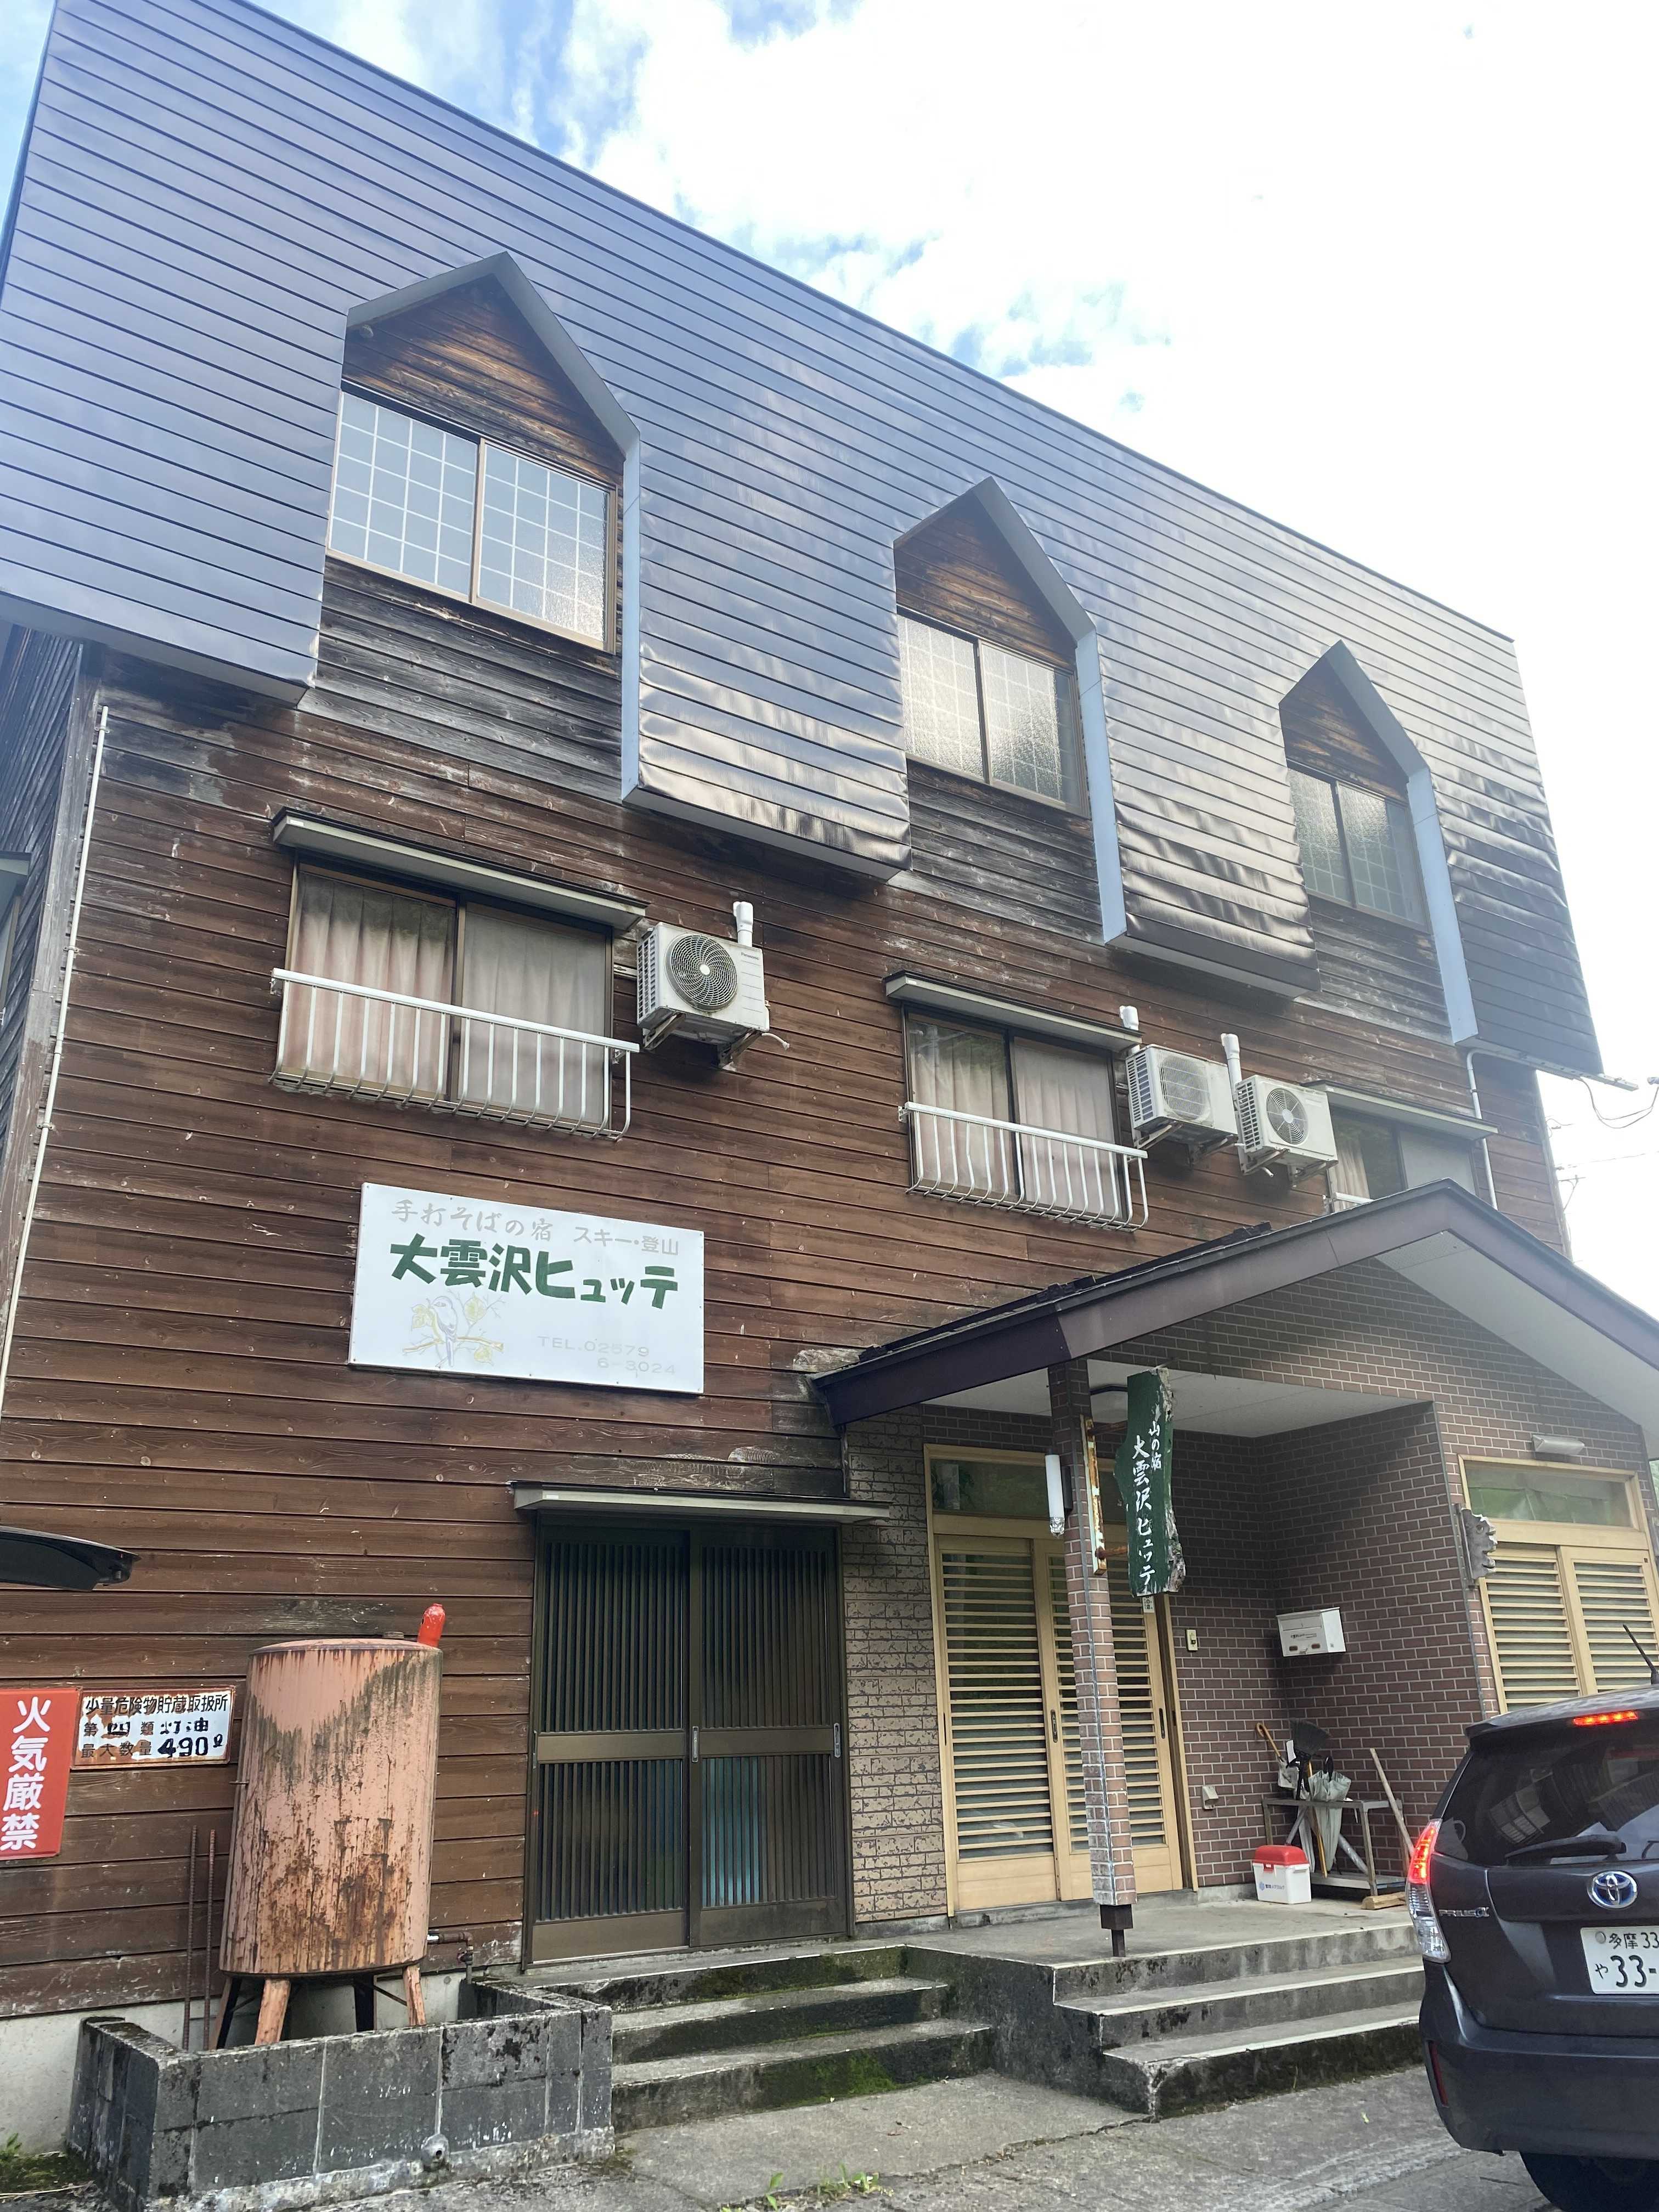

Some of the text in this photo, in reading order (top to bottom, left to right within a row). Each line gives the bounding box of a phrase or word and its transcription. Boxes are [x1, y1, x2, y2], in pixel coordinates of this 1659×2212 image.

[392, 1199, 552, 1242] 手打そばの宿
[390, 1233, 679, 1309] 大雲沢ヒュッテ
[597, 1357, 675, 1375] 6-3024
[1148, 1421, 1162, 1470] 山の宿
[1132, 1435, 1155, 1585] 大雲沢ヒュッテ
[85, 1694, 228, 1715] 少量危険物貯蔵取扱所
[1, 1696, 52, 1851] 火気厳禁
